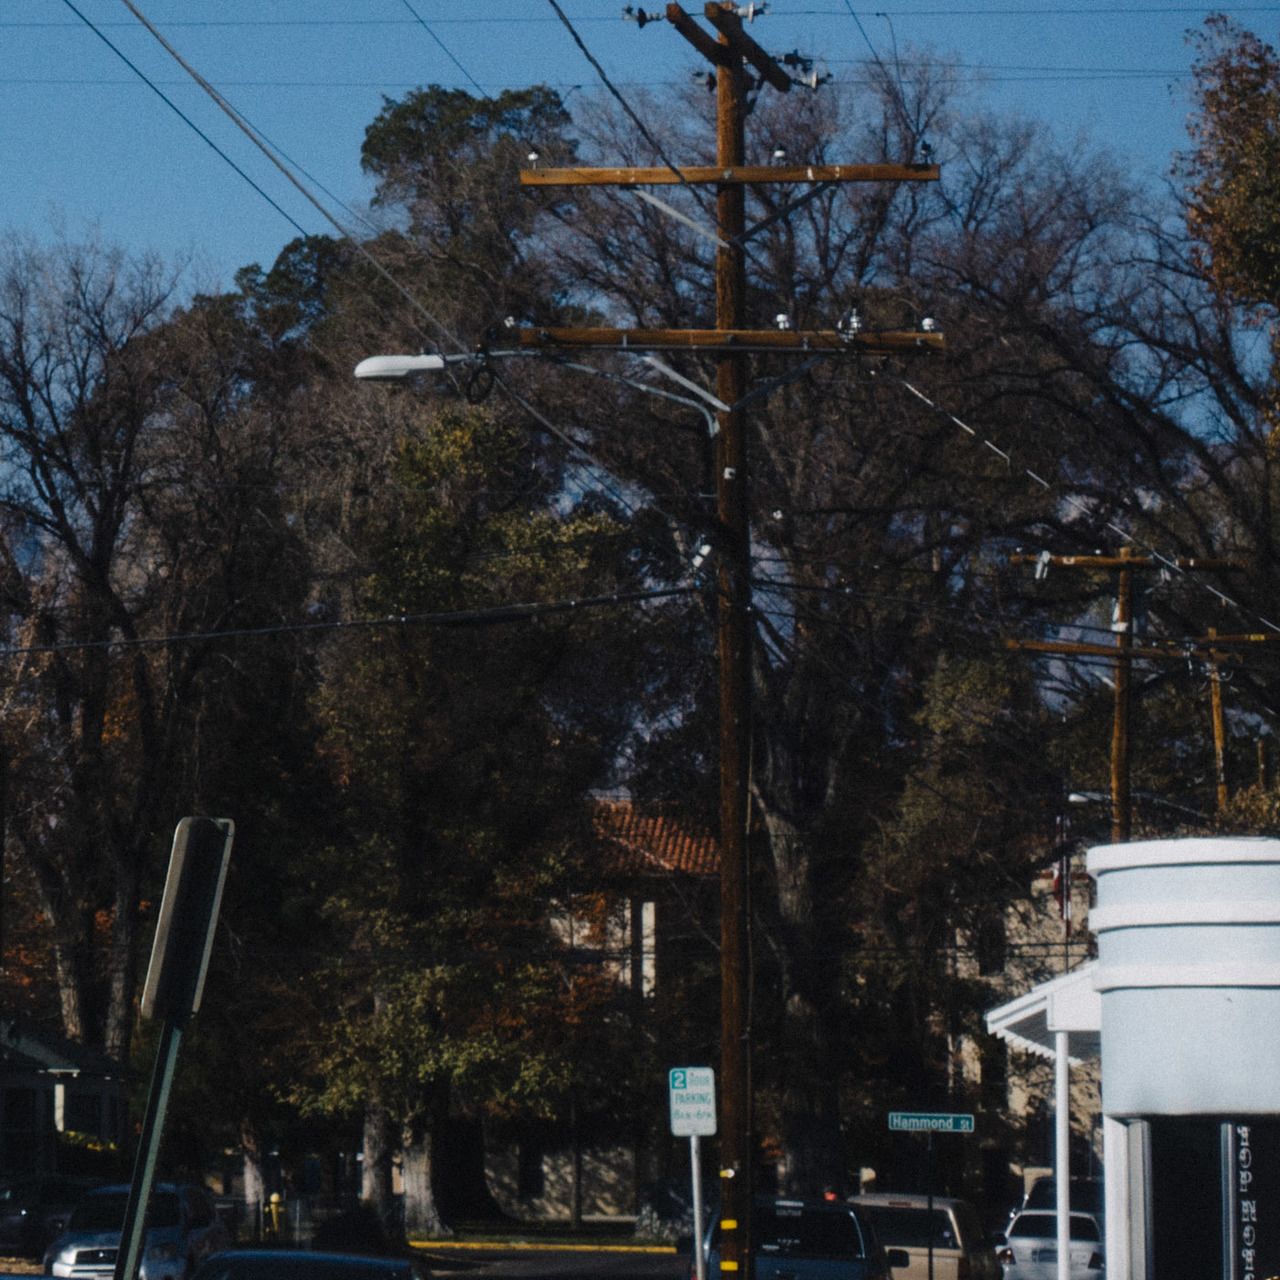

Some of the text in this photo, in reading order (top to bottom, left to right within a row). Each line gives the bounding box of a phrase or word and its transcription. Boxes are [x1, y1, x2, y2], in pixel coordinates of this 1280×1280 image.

[674, 1072, 685, 1088] 2
[674, 1092, 711, 1105] PARKING
[892, 1115, 970, 1129] Hammond St
